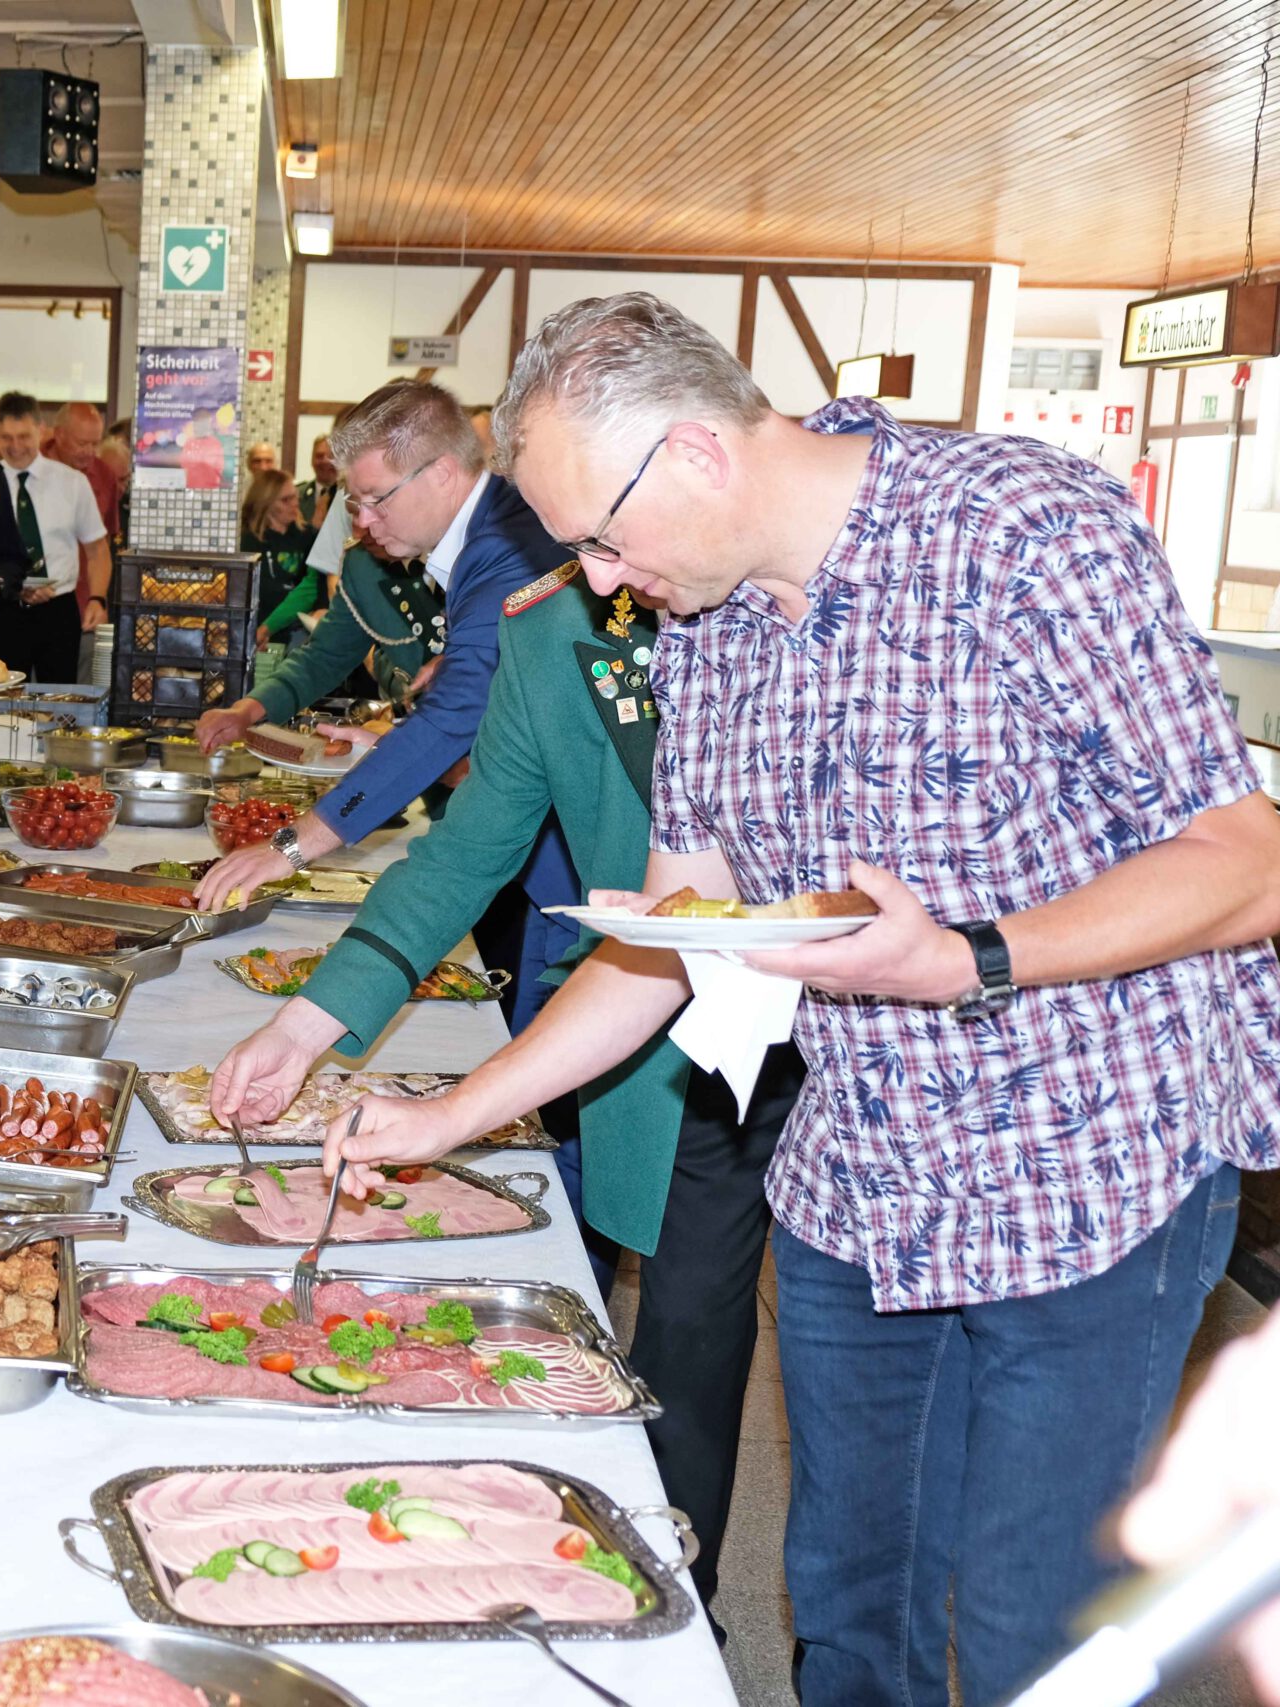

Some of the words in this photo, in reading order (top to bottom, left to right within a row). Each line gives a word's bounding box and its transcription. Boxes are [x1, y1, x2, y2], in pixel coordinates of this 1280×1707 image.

[1149, 304, 1217, 353] Krombacher
[146, 353, 220, 371] Sicherheit
[145, 371, 178, 389] geht
